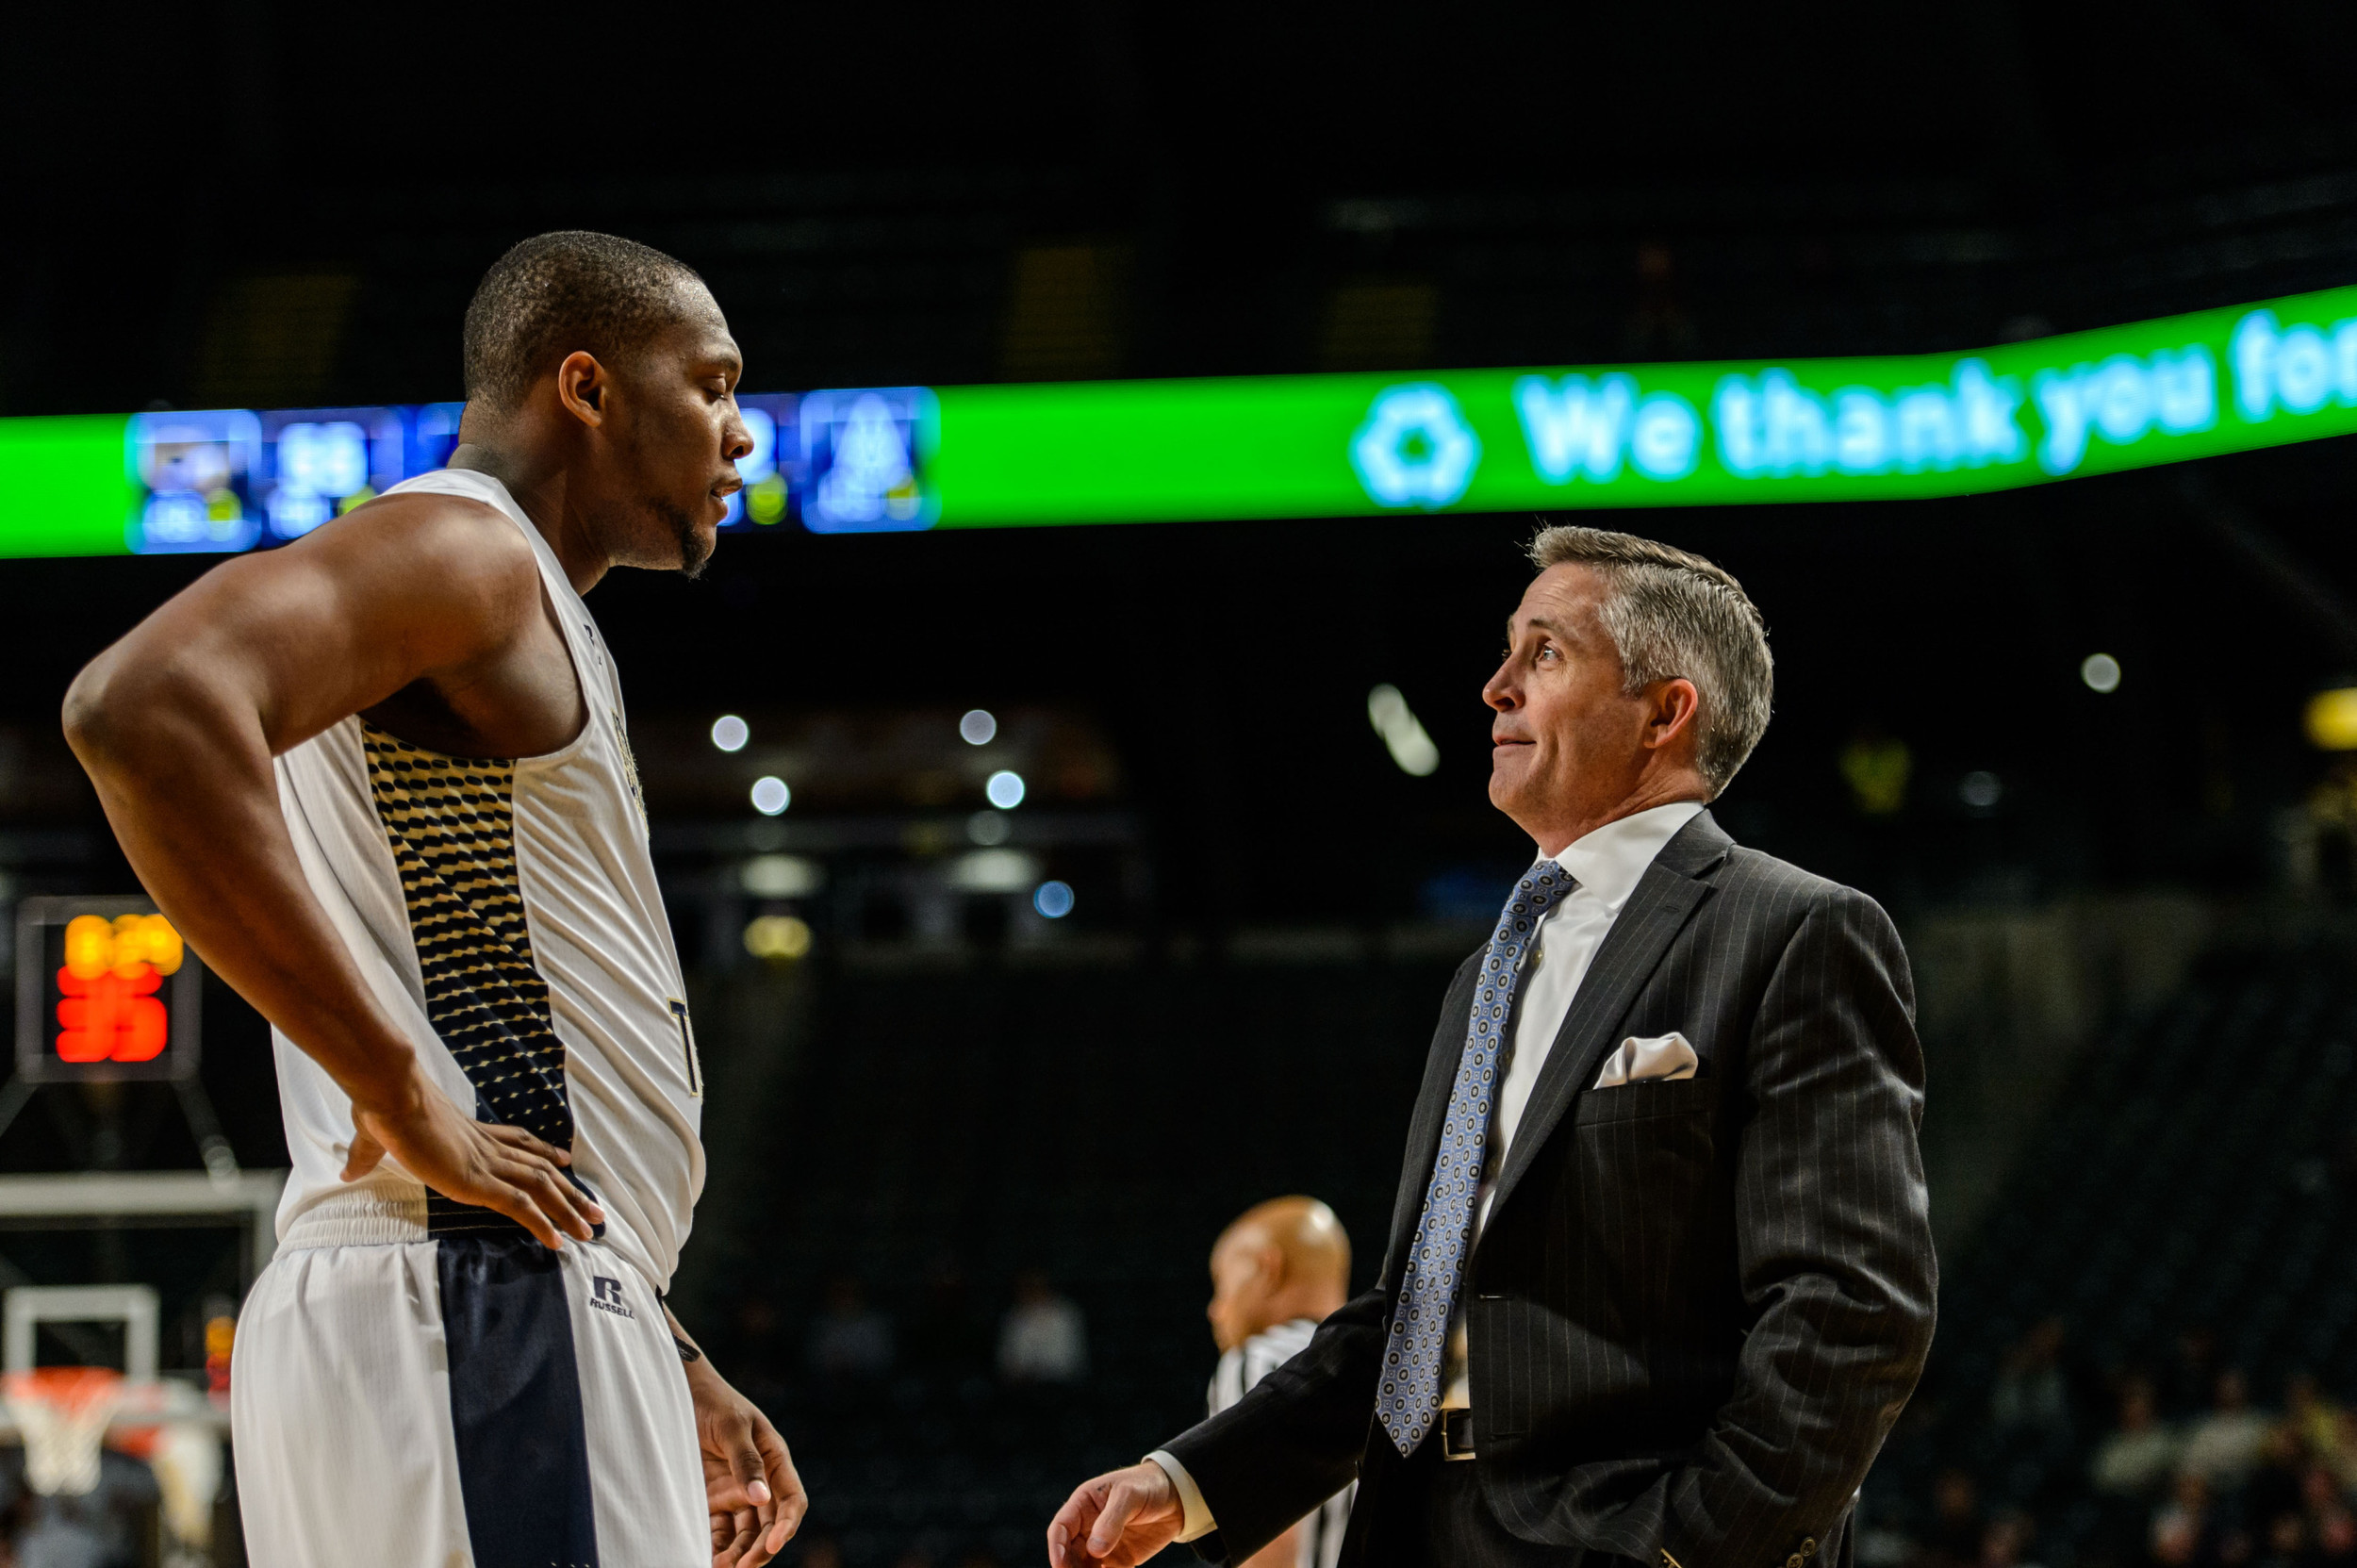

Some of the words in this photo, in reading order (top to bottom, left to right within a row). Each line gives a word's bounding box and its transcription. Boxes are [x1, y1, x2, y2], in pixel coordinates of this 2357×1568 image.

[1513, 373, 1702, 485] We
[1709, 359, 2029, 479] thank
[2032, 343, 2217, 475] you
[590, 1297, 635, 1320] RUSSELL
